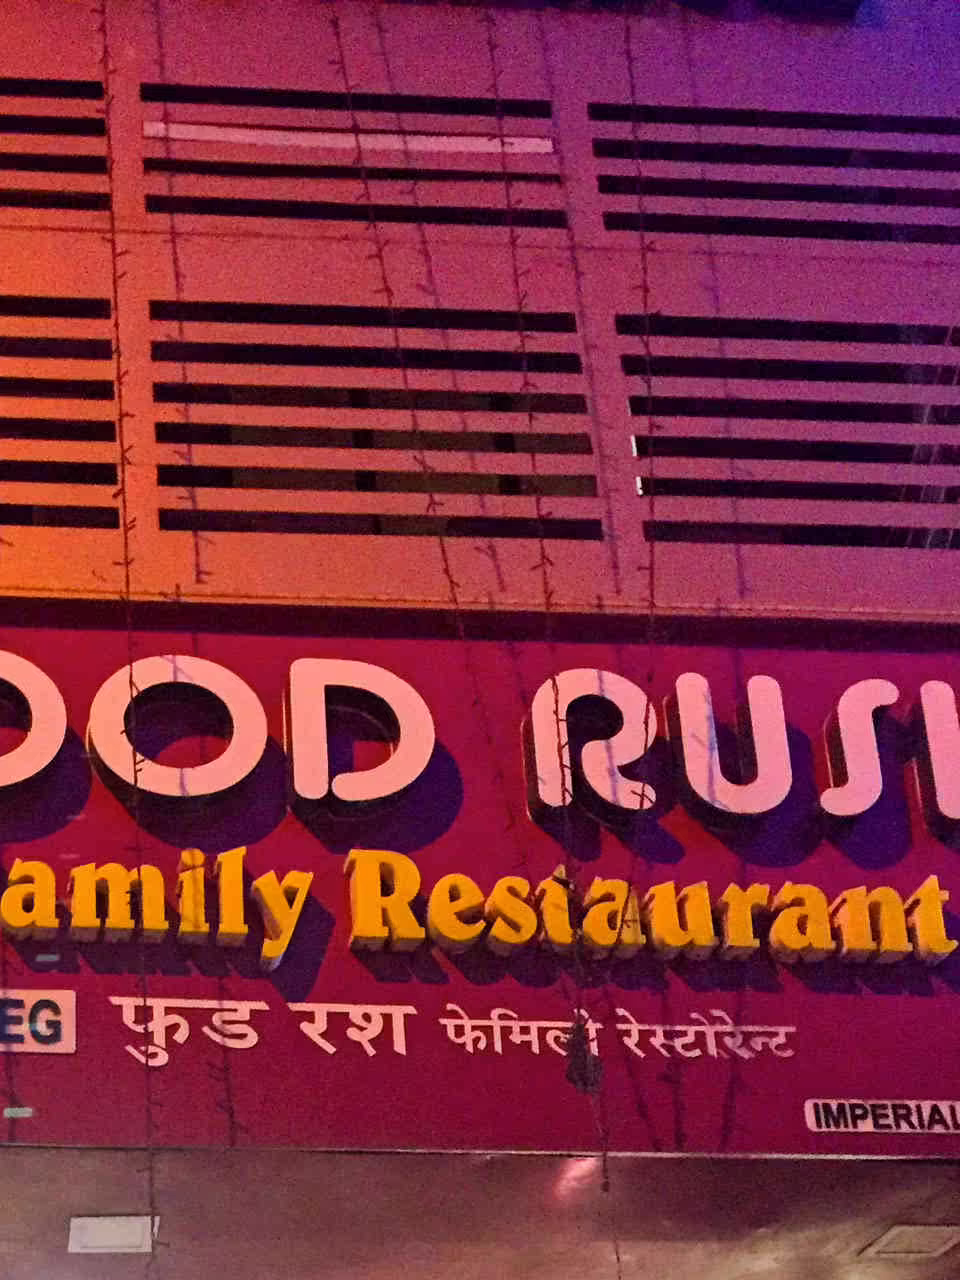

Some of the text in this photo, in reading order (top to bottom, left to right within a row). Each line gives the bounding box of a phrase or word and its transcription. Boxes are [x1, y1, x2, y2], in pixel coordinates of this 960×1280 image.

[344, 848, 959, 962] Restaurant
[108, 996, 270, 1067] फुड
[287, 1002, 418, 1057] रश
